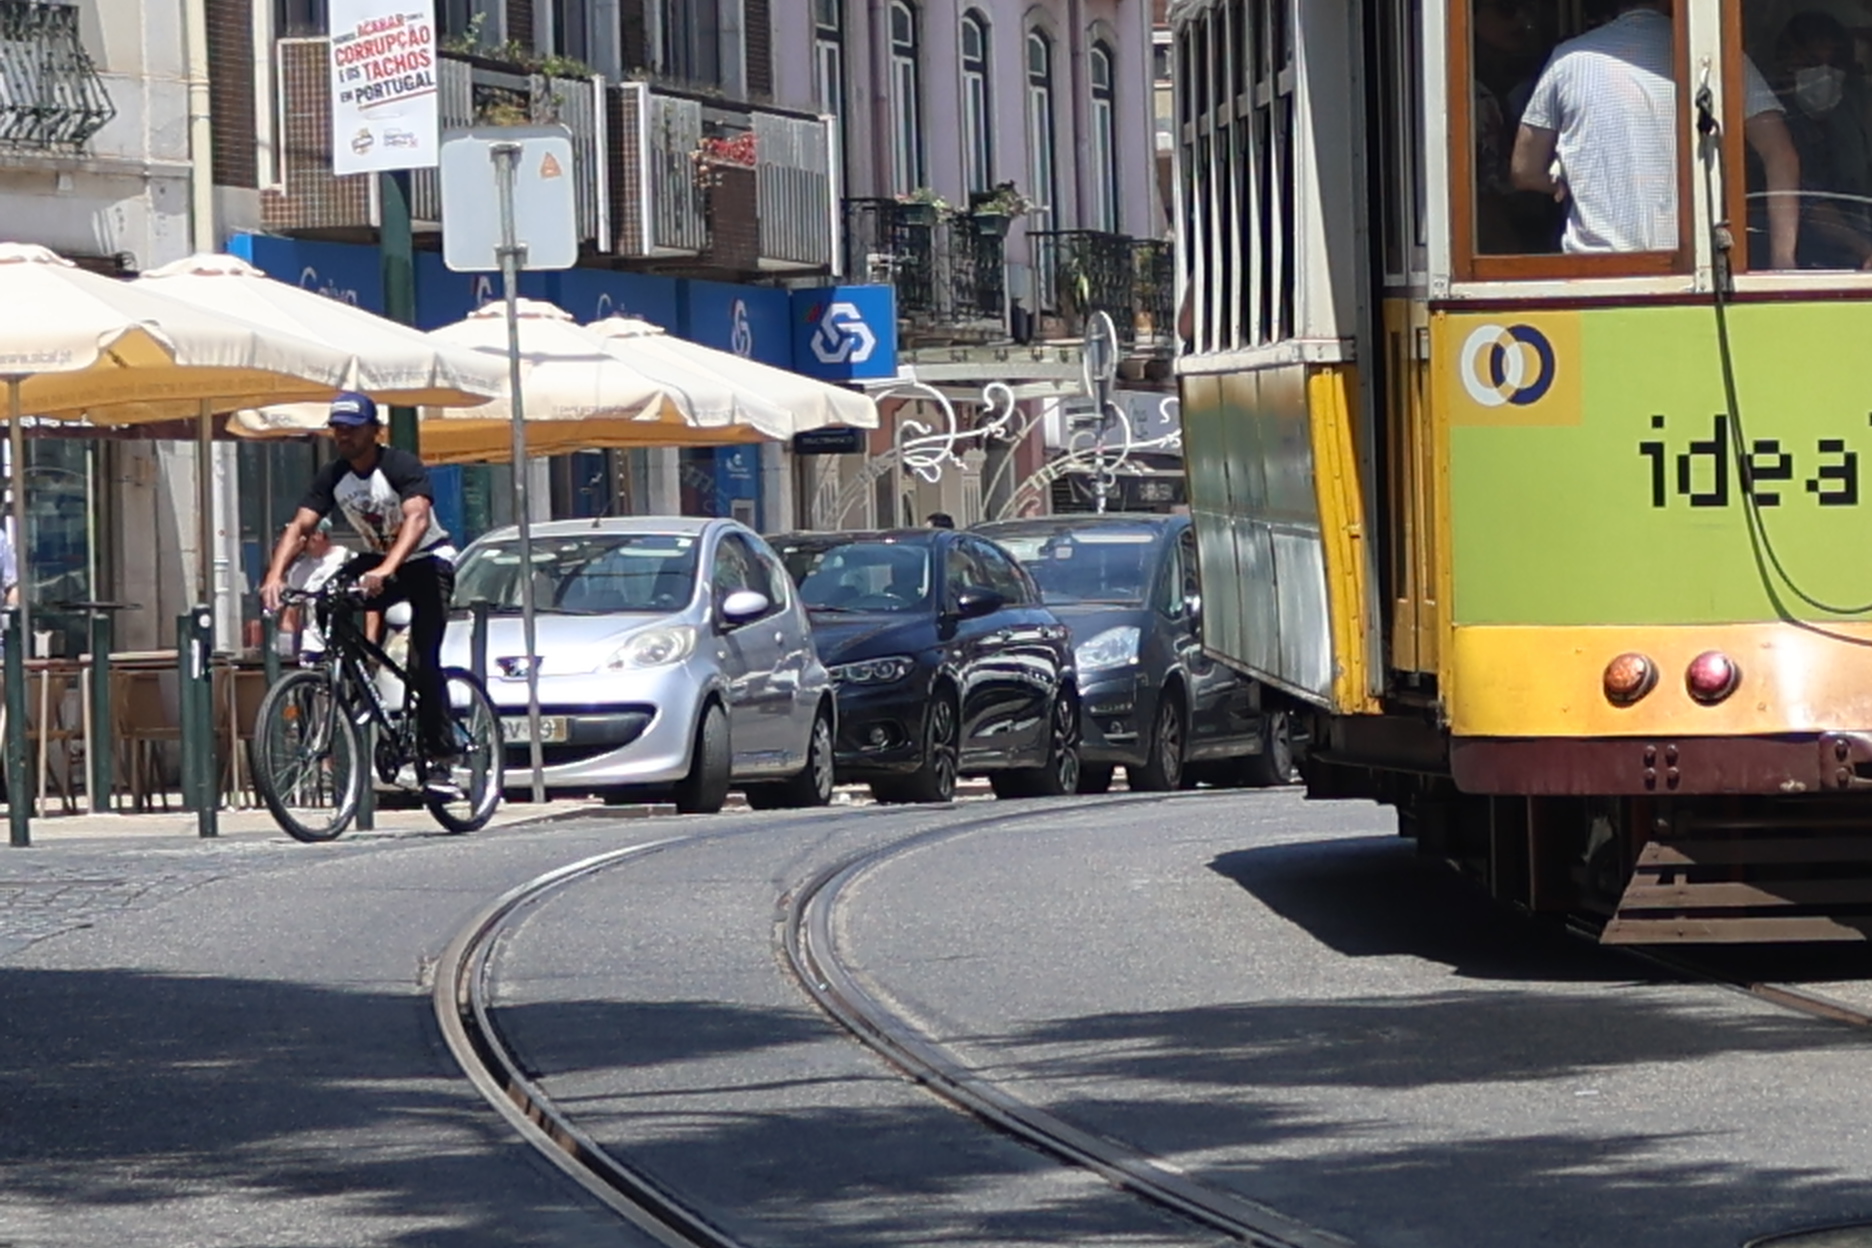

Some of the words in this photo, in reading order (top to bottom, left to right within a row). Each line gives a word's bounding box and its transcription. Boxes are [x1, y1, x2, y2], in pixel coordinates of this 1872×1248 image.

[335, 25, 431, 66] CORRUPÇÃO
[362, 48, 432, 81] TACHOS
[355, 70, 435, 104] PORTUGAL
